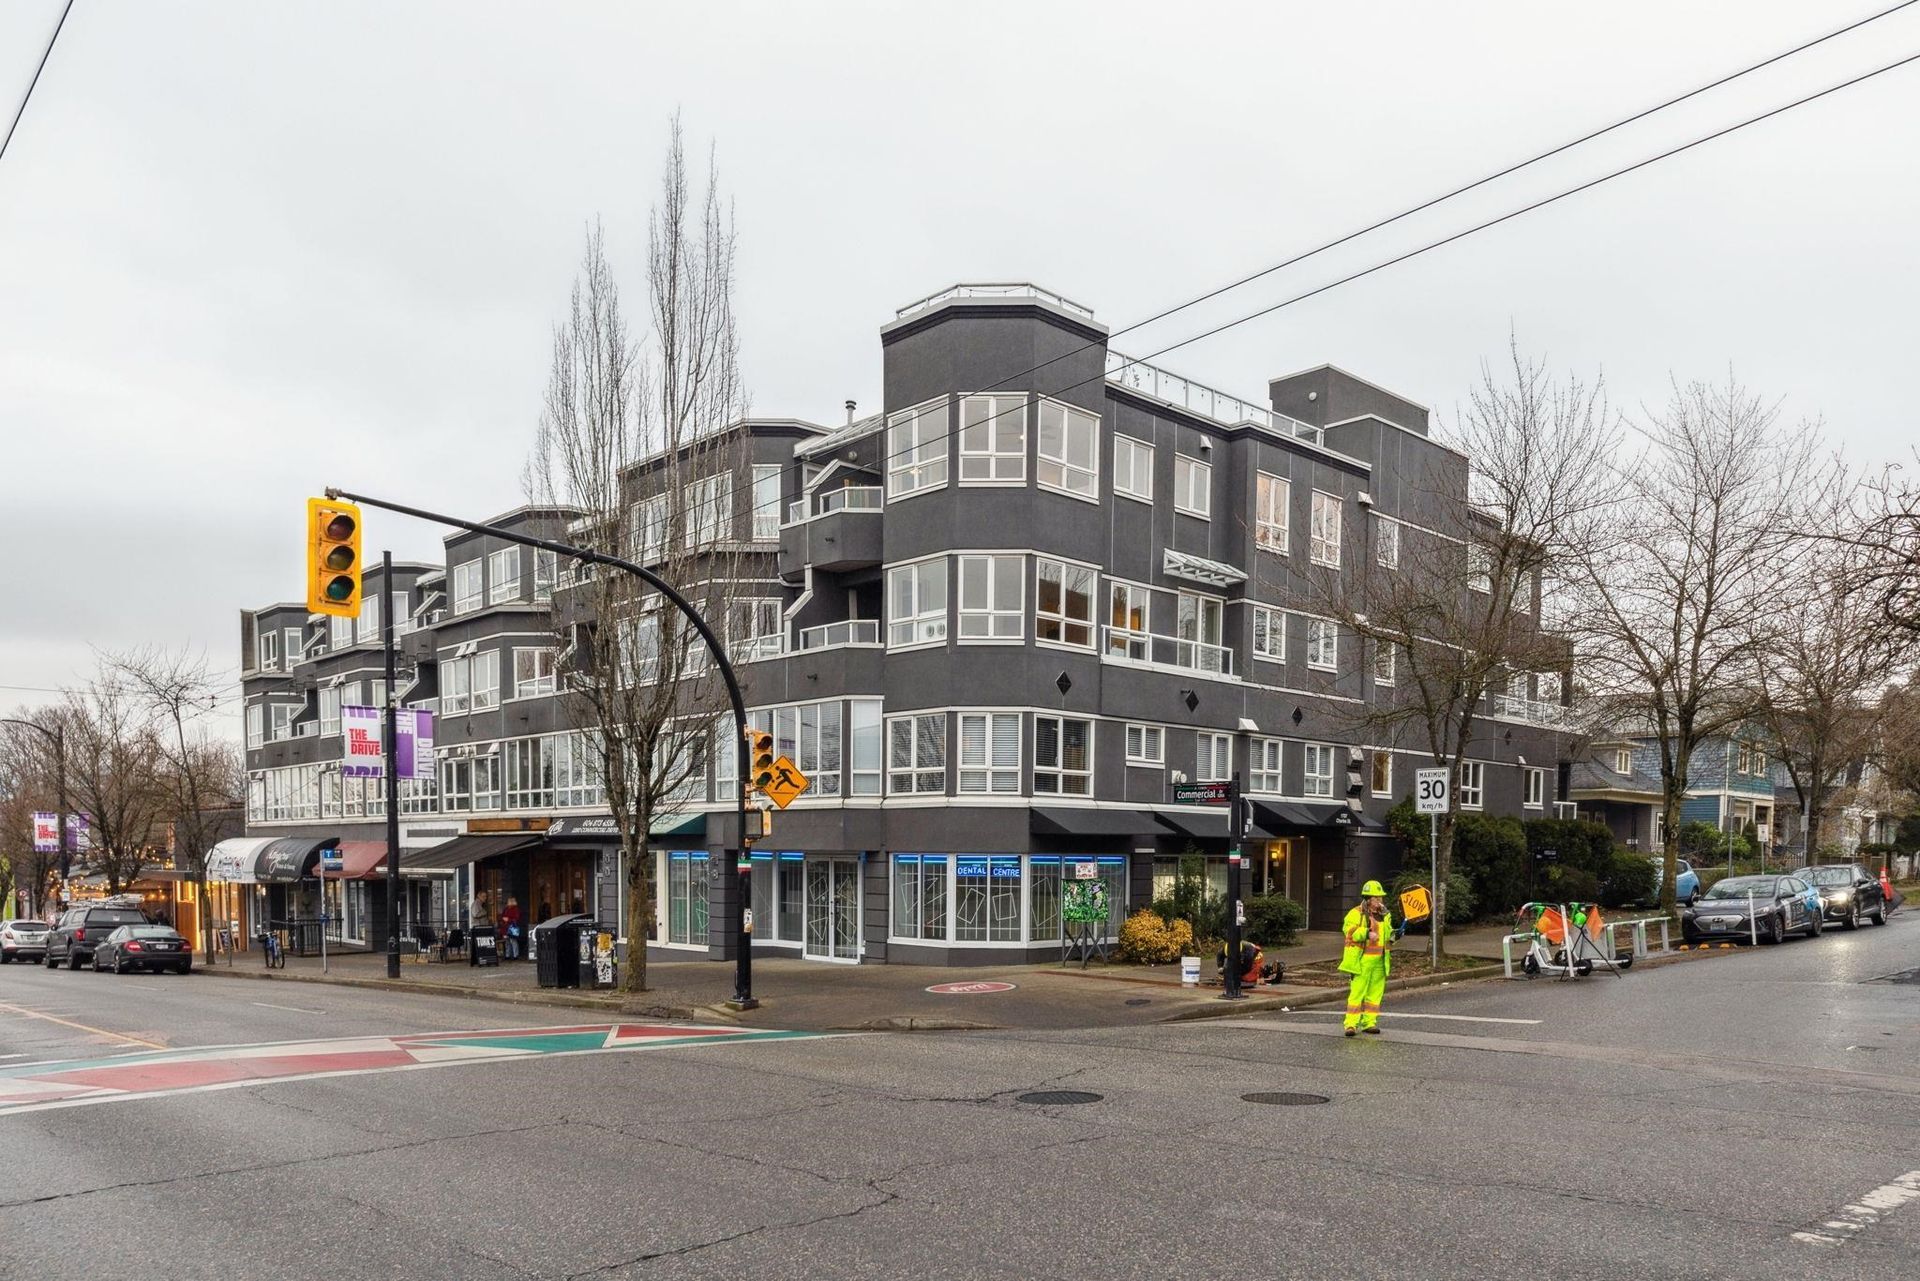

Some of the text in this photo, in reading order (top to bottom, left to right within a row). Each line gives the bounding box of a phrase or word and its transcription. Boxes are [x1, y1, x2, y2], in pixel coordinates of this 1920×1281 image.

[349, 728, 367, 740] THE
[351, 743, 381, 756] DRIVE
[1177, 789, 1216, 799] Commercial
[1420, 780, 1445, 799] 30
[957, 866, 1020, 877] DENTAL CENTRE
[1403, 894, 1427, 913] SLOW
[476, 936, 496, 947] TURK'S
